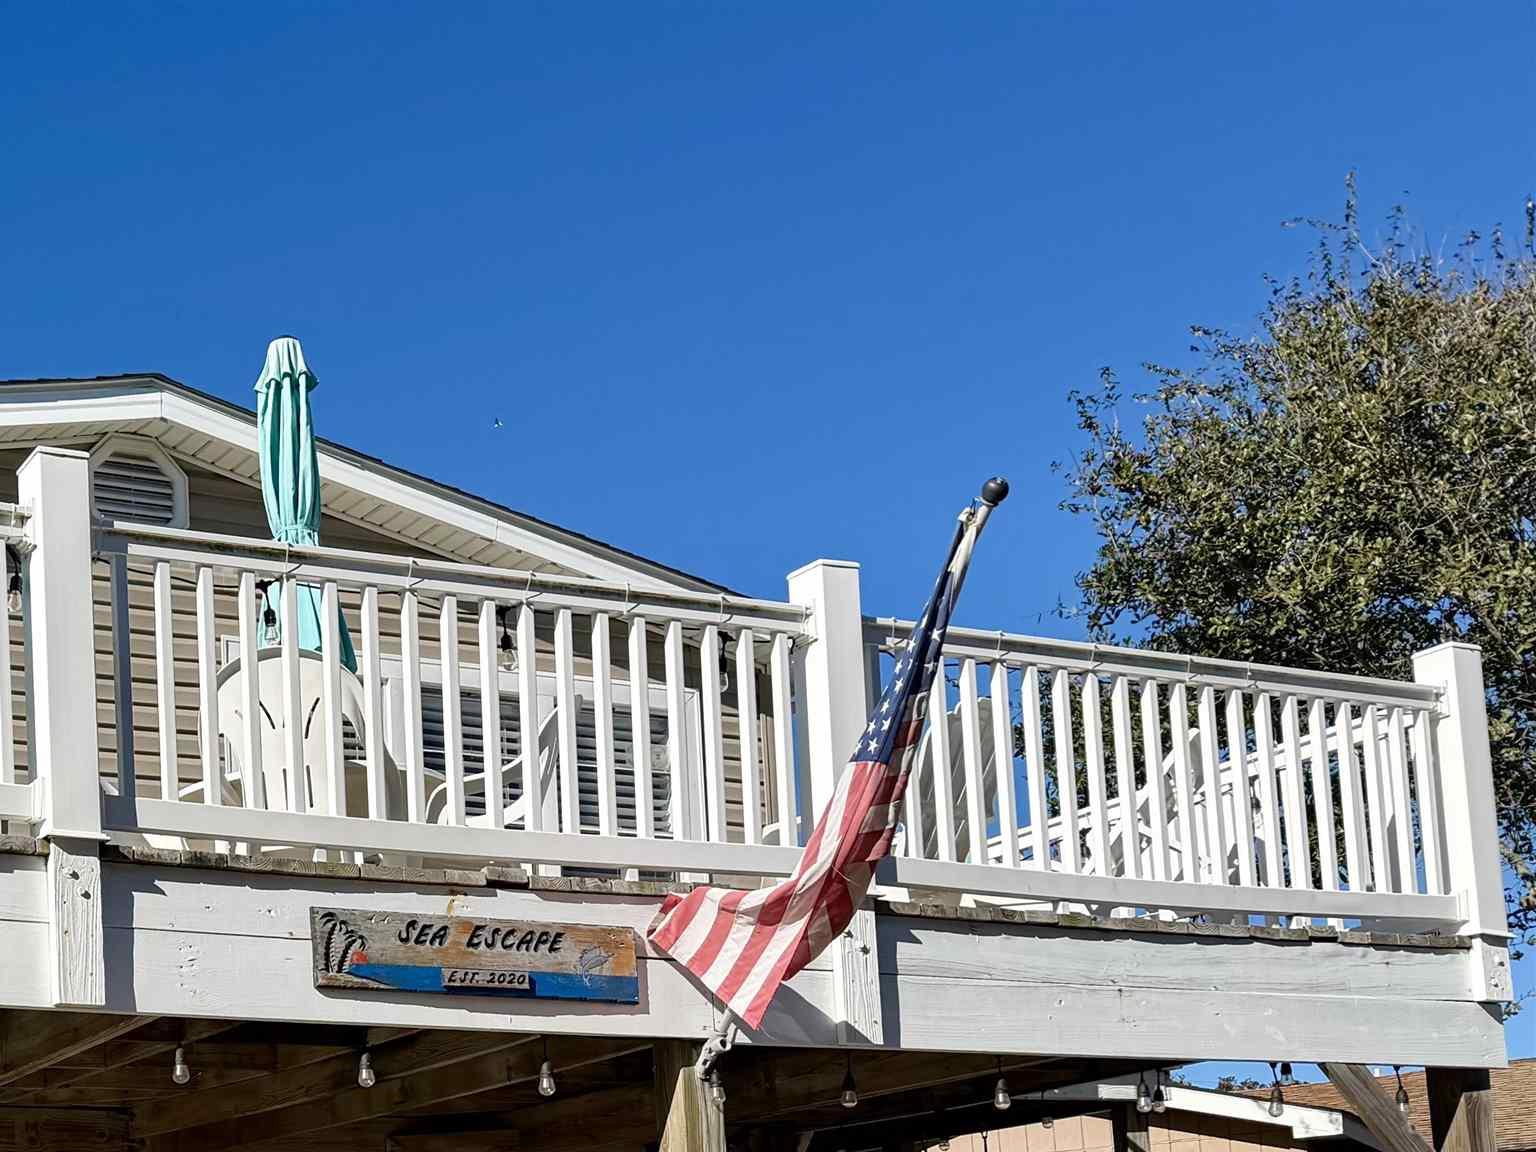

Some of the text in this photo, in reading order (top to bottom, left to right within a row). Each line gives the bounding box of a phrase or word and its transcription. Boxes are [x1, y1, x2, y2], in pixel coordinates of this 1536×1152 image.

[398, 919, 565, 953] SEA ESCAPE
[485, 972, 528, 986] 2020
